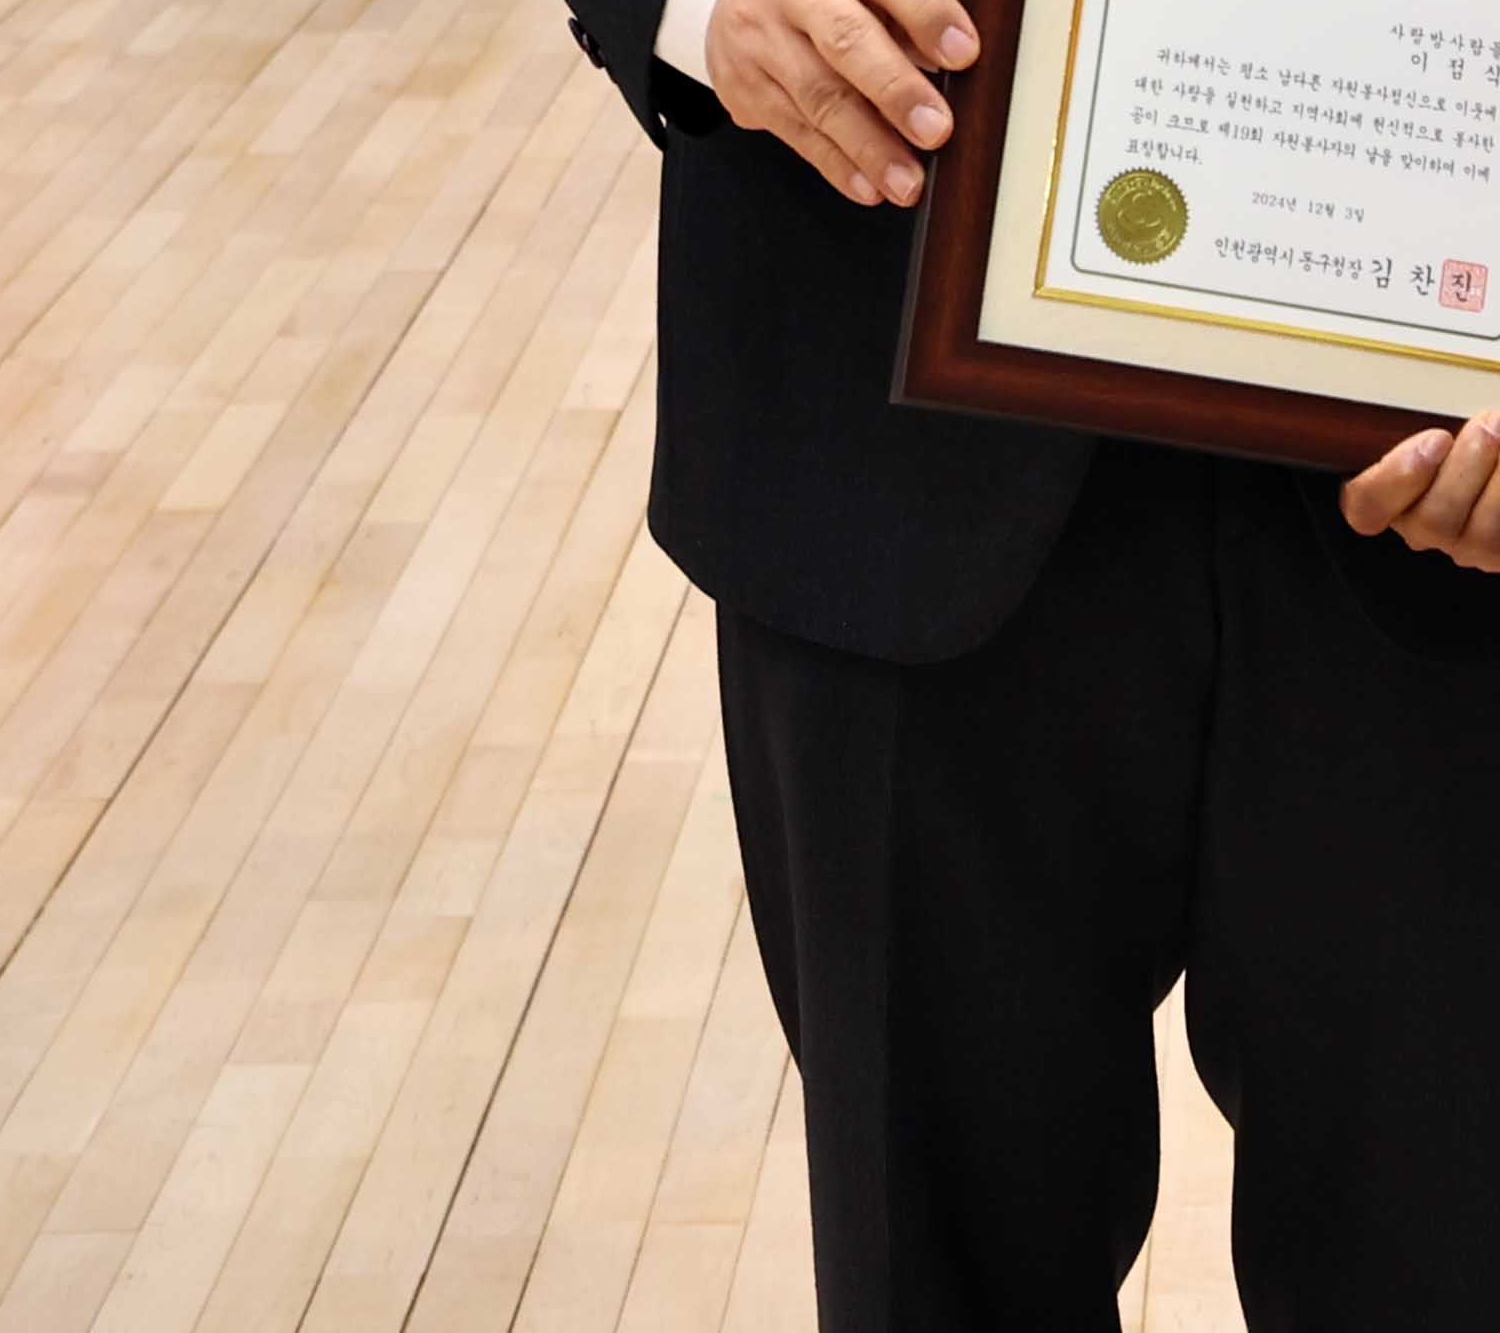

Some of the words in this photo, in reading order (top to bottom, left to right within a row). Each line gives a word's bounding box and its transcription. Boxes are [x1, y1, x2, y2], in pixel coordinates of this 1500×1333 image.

[1279, 68, 1321, 91] 남다른
[1252, 192, 1297, 213] 2024년
[1308, 199, 1334, 218] 12월
[1214, 237, 1294, 266] 인천광역시
[1299, 251, 1363, 279] 동구청장
